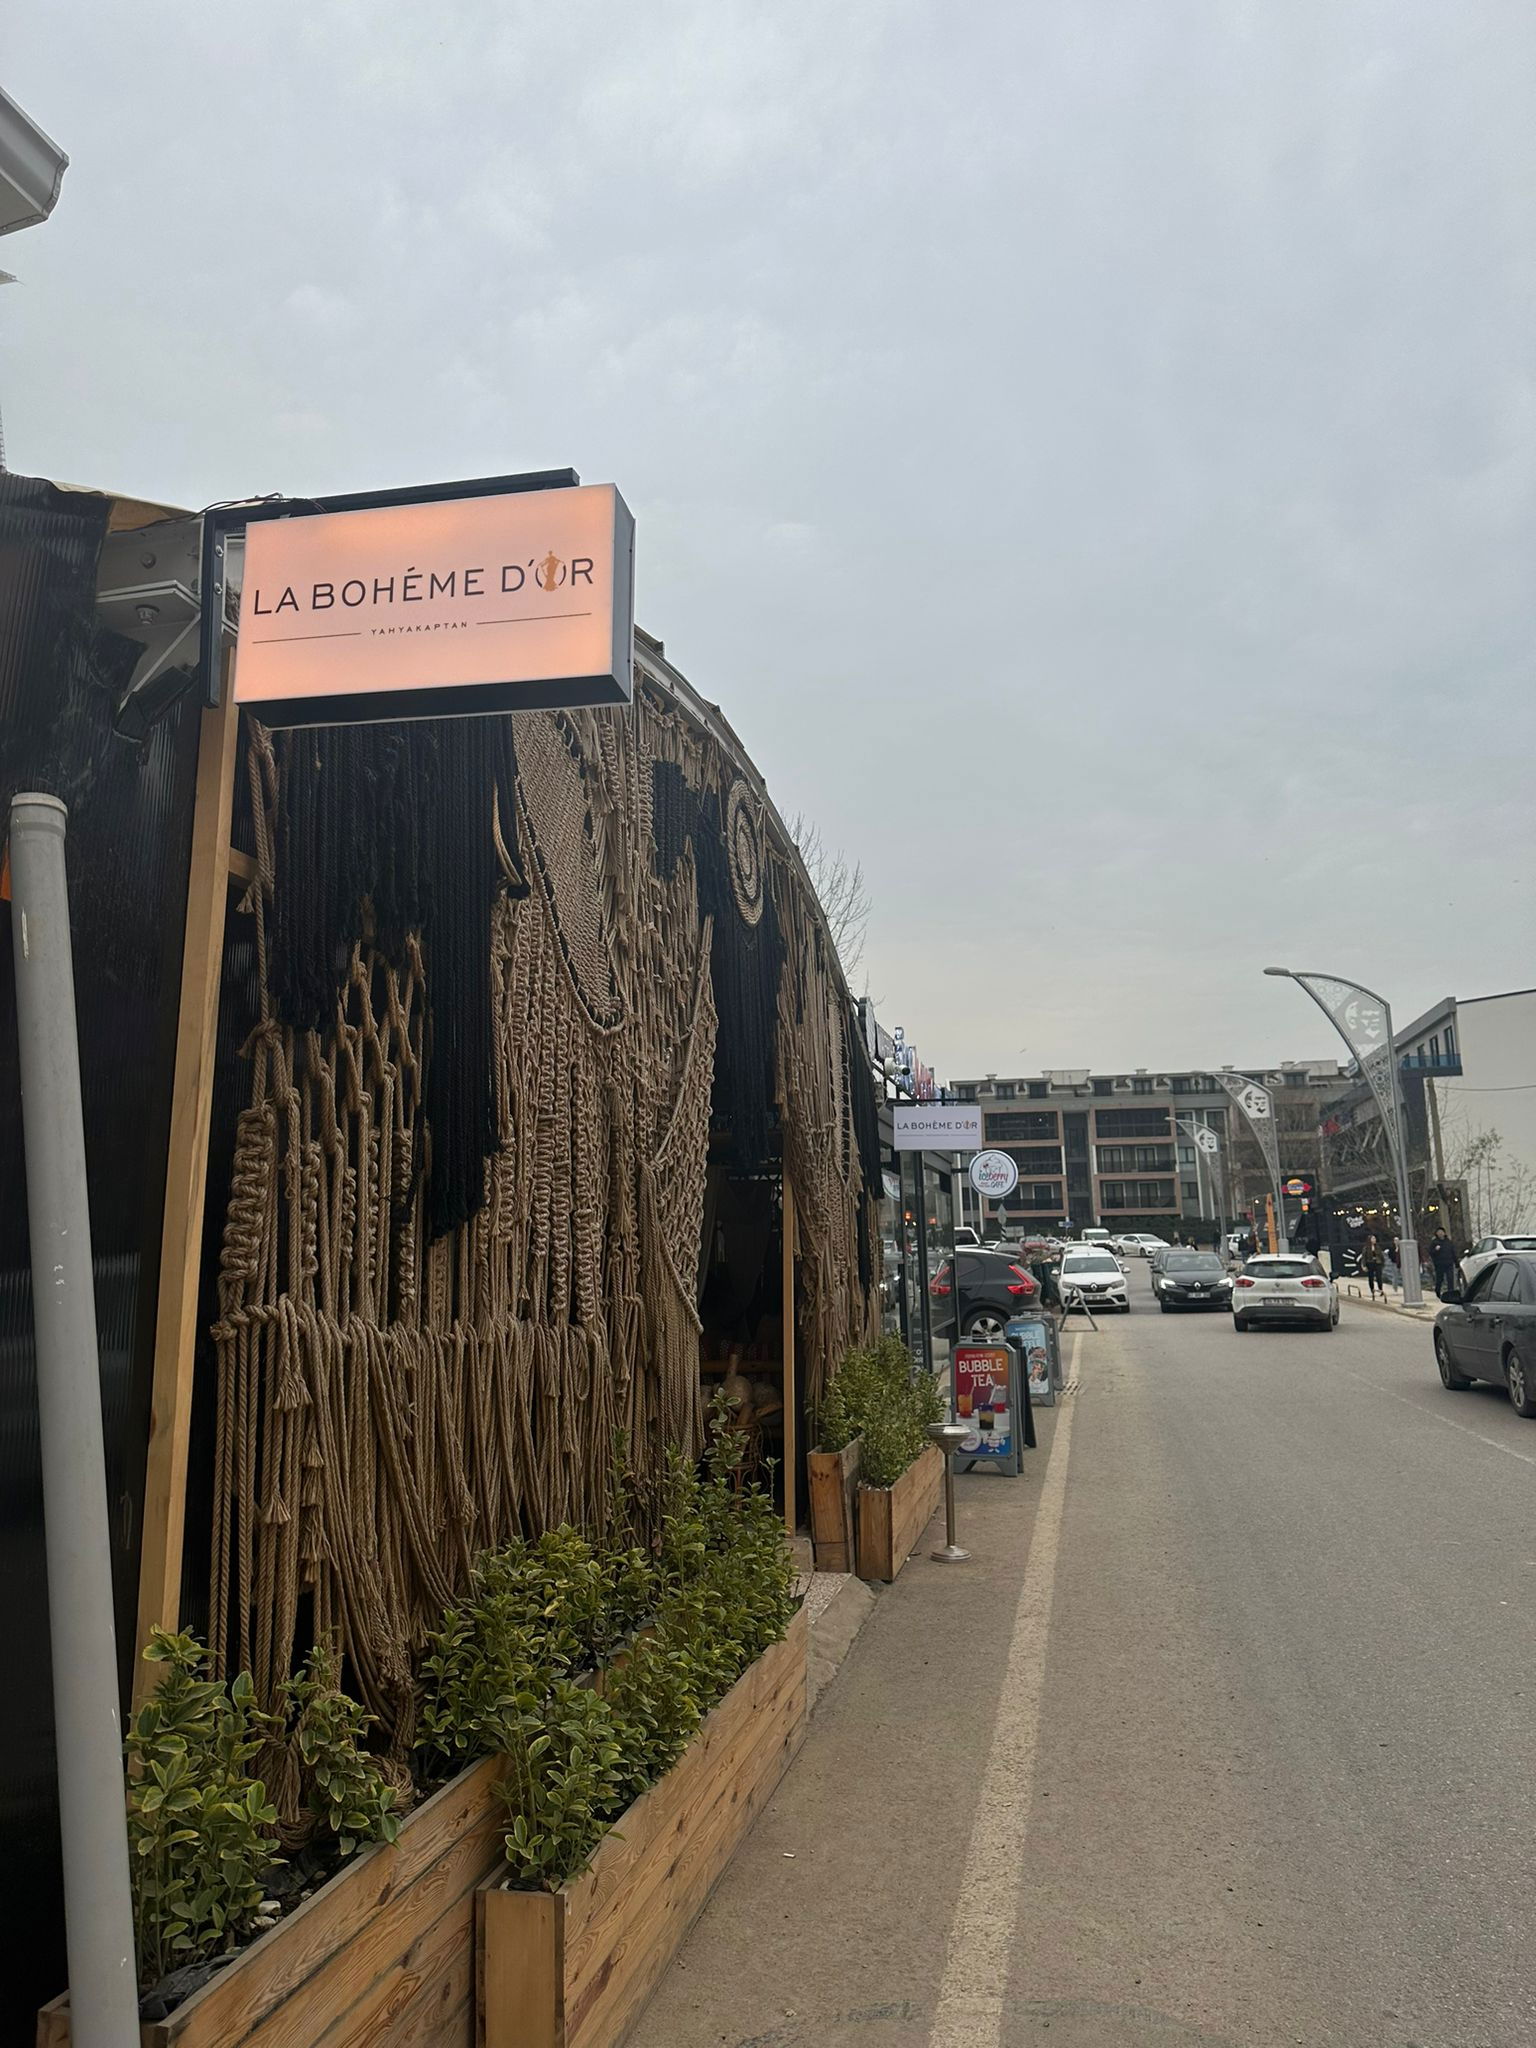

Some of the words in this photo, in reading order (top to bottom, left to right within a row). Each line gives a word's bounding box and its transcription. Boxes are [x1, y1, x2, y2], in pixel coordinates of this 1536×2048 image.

[253, 587, 300, 616] LA
[312, 566, 485, 611] BOHÉME
[371, 621, 469, 637] YAHYAKAPTAN
[897, 1122, 909, 1130] LA
[958, 1358, 1004, 1374] BUBBLE
[970, 1374, 994, 1387] TEA
